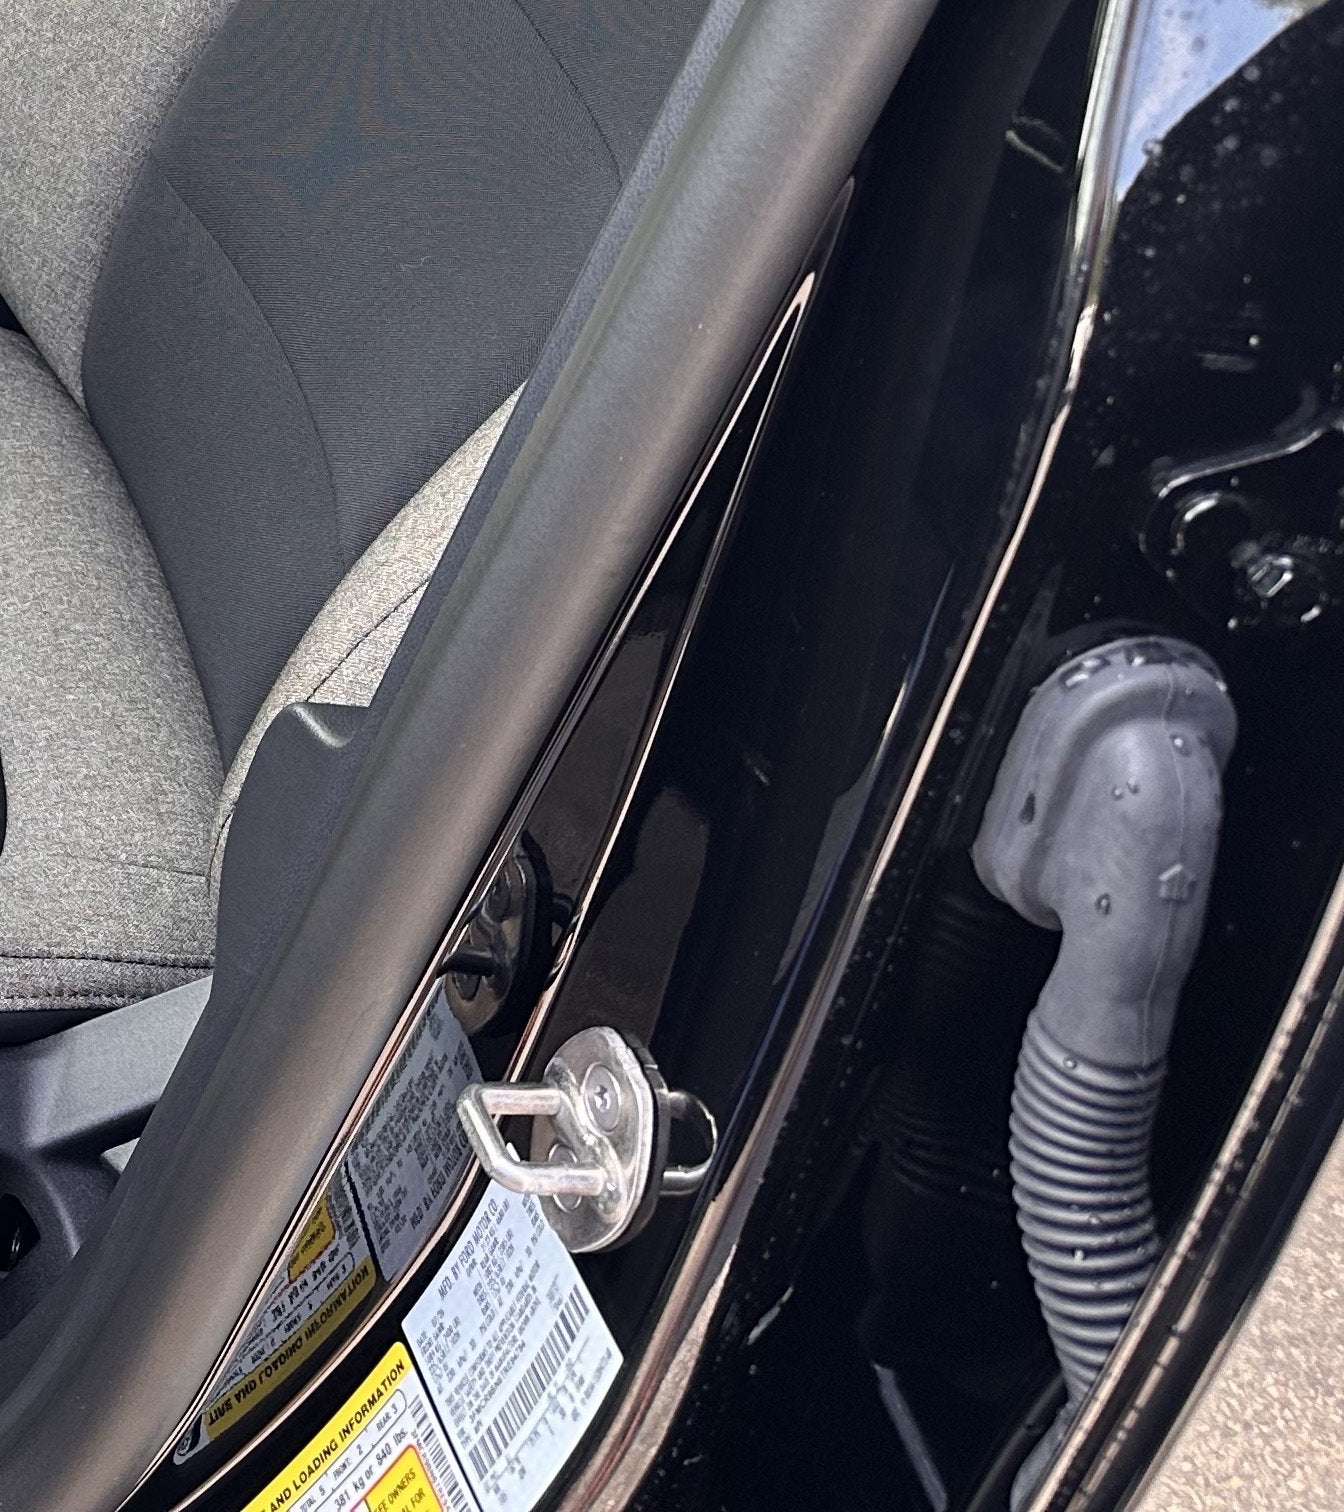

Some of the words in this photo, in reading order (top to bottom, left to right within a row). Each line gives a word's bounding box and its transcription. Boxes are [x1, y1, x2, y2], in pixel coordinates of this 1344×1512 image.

[458, 1240, 475, 1268] FORD
[471, 1211, 492, 1246] MOTOR
[268, 1484, 292, 1512] AND
[292, 1436, 338, 1492] LOADING
[337, 1358, 405, 1442] INFORMATION
[333, 1488, 351, 1511] 381
[351, 1473, 366, 1493] kg
[362, 1463, 374, 1479] or
